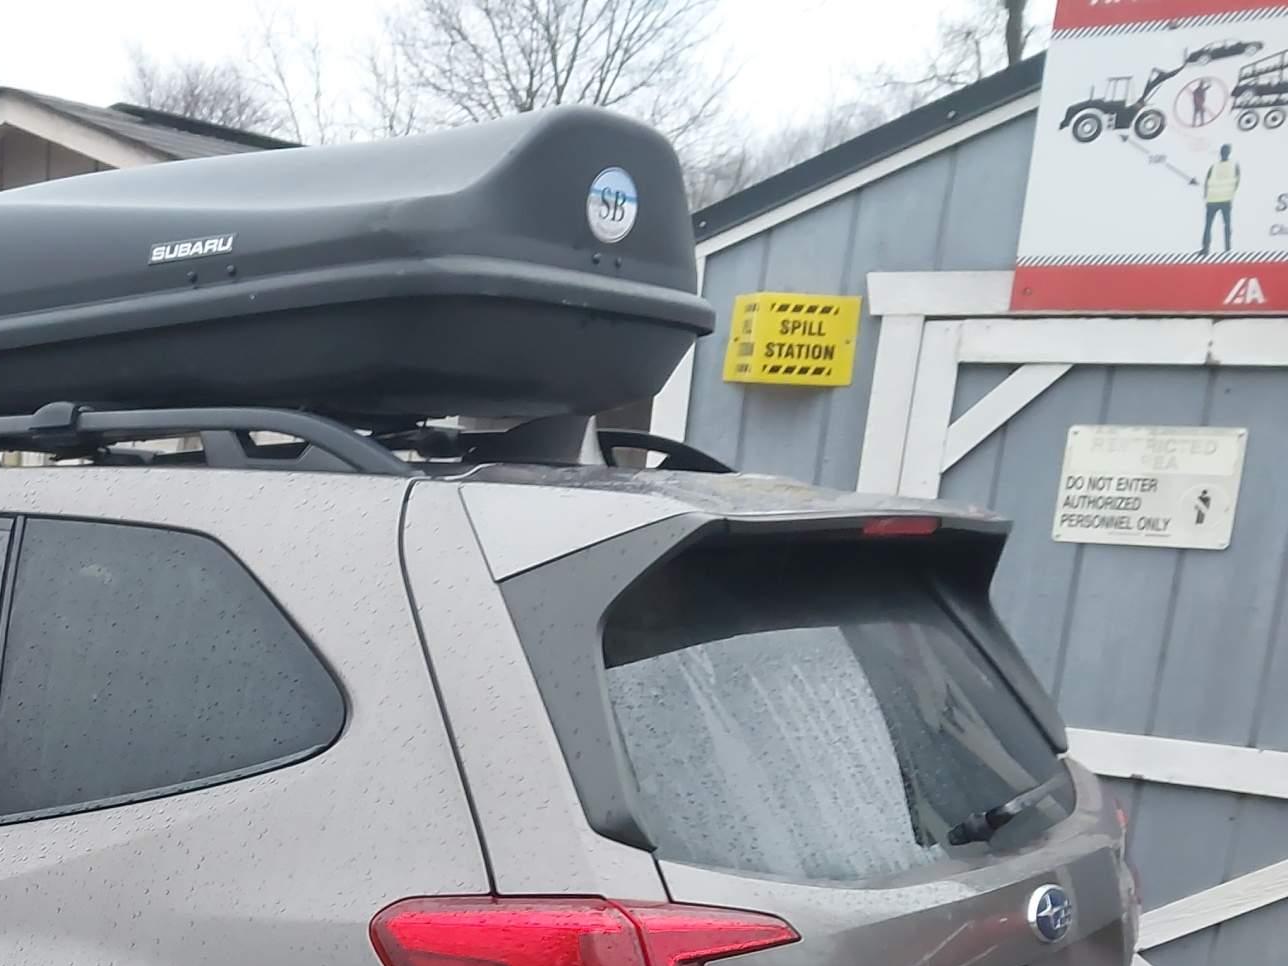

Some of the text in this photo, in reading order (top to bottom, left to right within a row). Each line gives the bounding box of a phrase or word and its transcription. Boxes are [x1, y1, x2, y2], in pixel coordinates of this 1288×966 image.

[599, 186, 626, 222] SB
[151, 236, 233, 261] SUBARU
[779, 319, 826, 337] SPILL
[765, 342, 835, 360] STATION
[1066, 476, 1158, 493] DO NOT ENTER
[1063, 496, 1142, 511] AUTHORIZED
[1060, 514, 1171, 531] PERSONNEL ONLY
